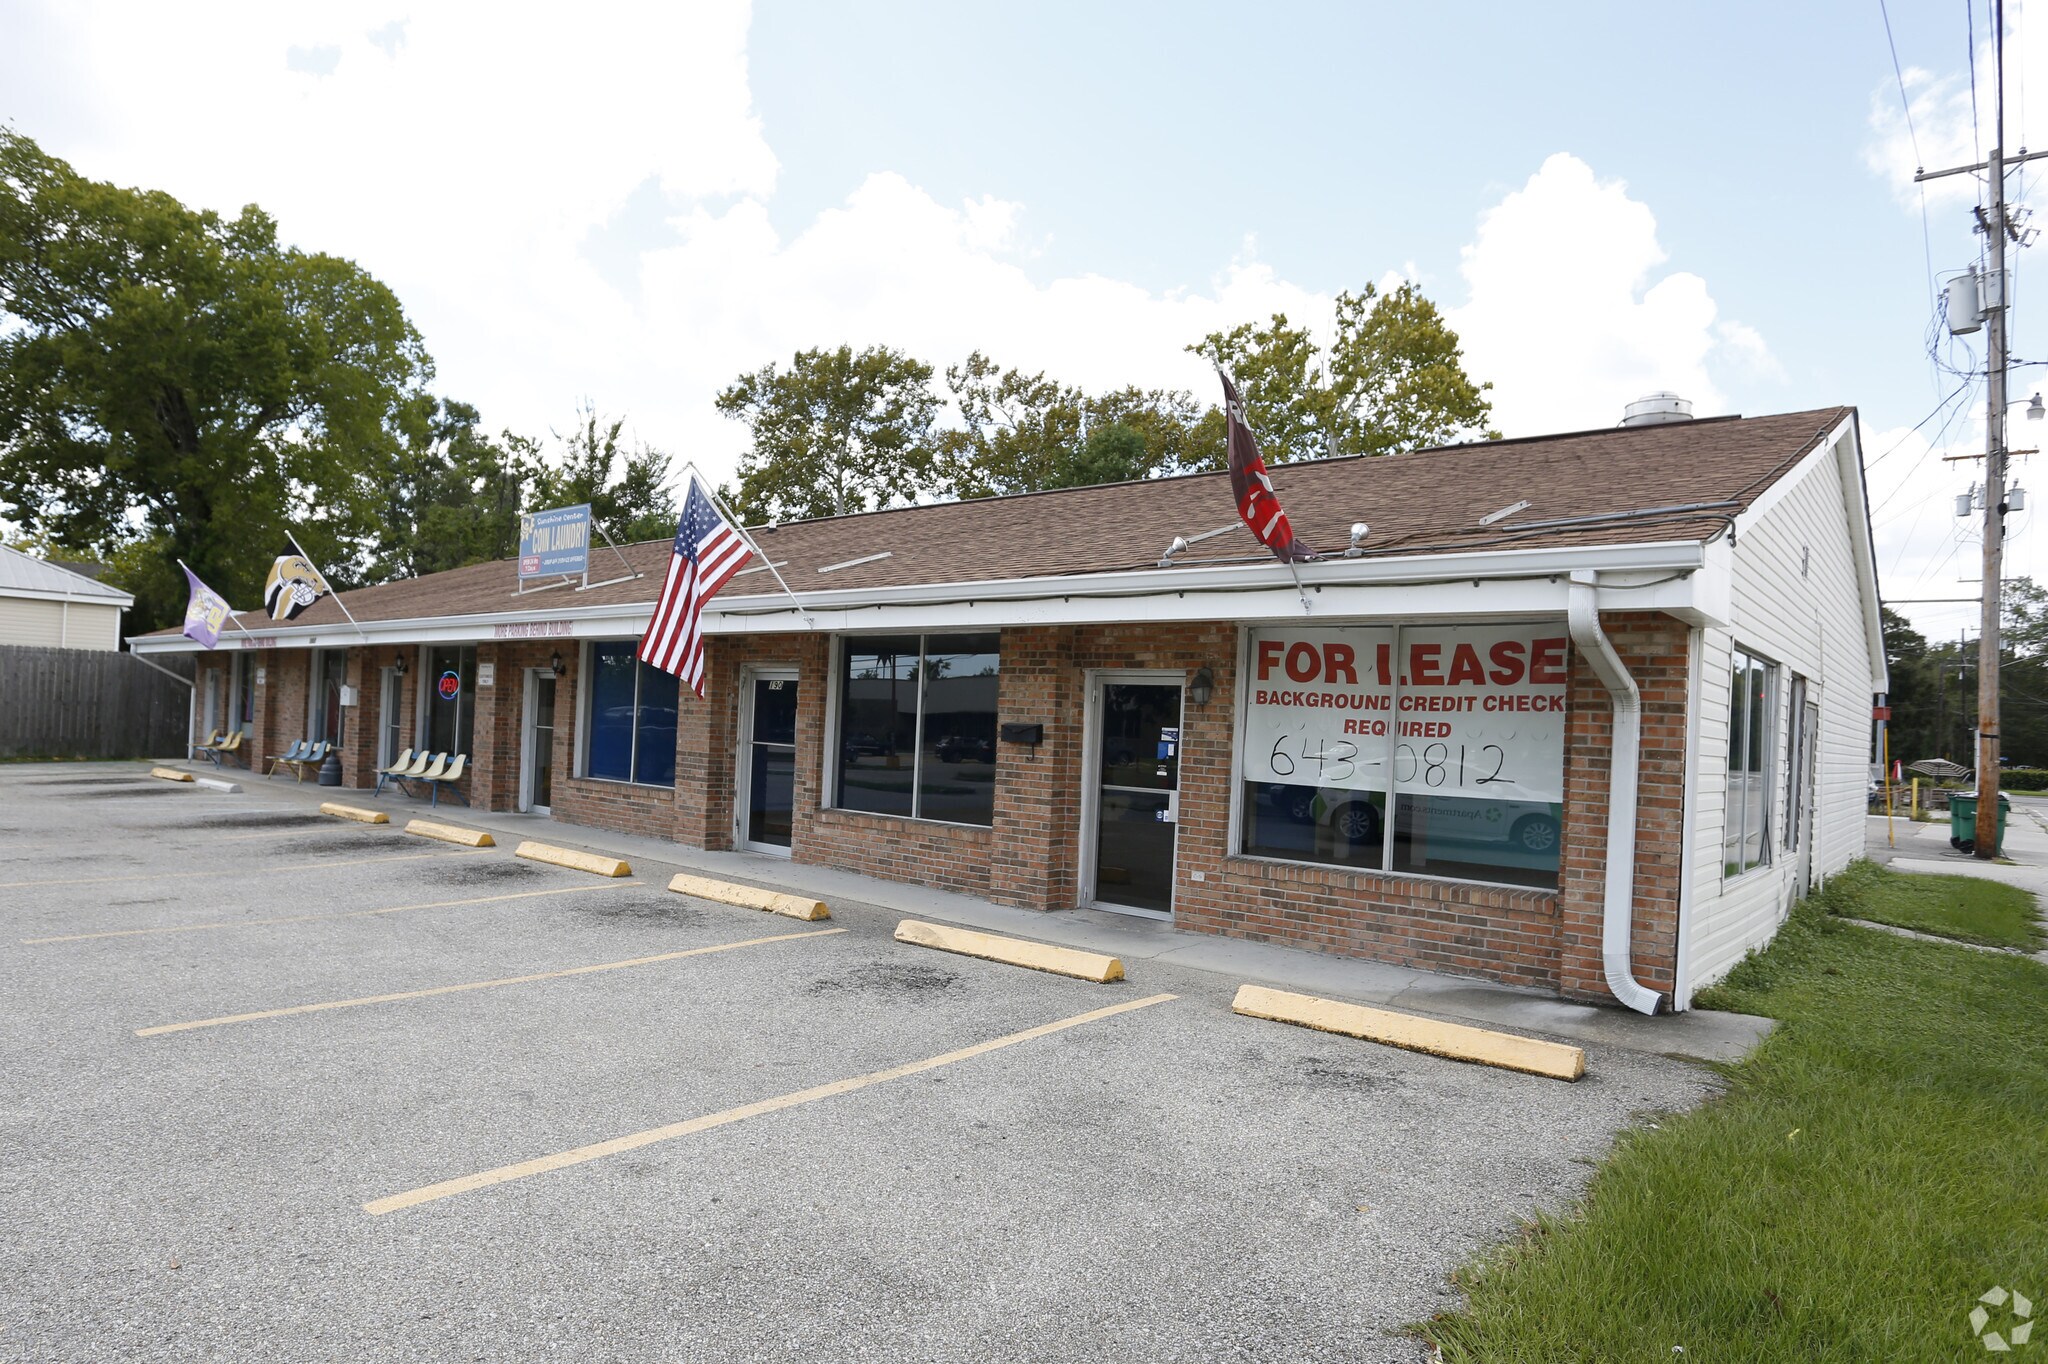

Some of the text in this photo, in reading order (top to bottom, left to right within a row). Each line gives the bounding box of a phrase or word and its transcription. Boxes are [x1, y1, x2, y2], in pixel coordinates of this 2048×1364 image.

[537, 513, 584, 525] Sunshine Center
[532, 521, 587, 554] COIN LAUNDRY
[494, 621, 574, 639] MORE PARKING BEHIND BUILDING
[1257, 637, 1567, 686] FOR LEASE
[440, 677, 459, 693] OPEN
[1256, 690, 1565, 712] BACKGROUND CREDIT CHECK
